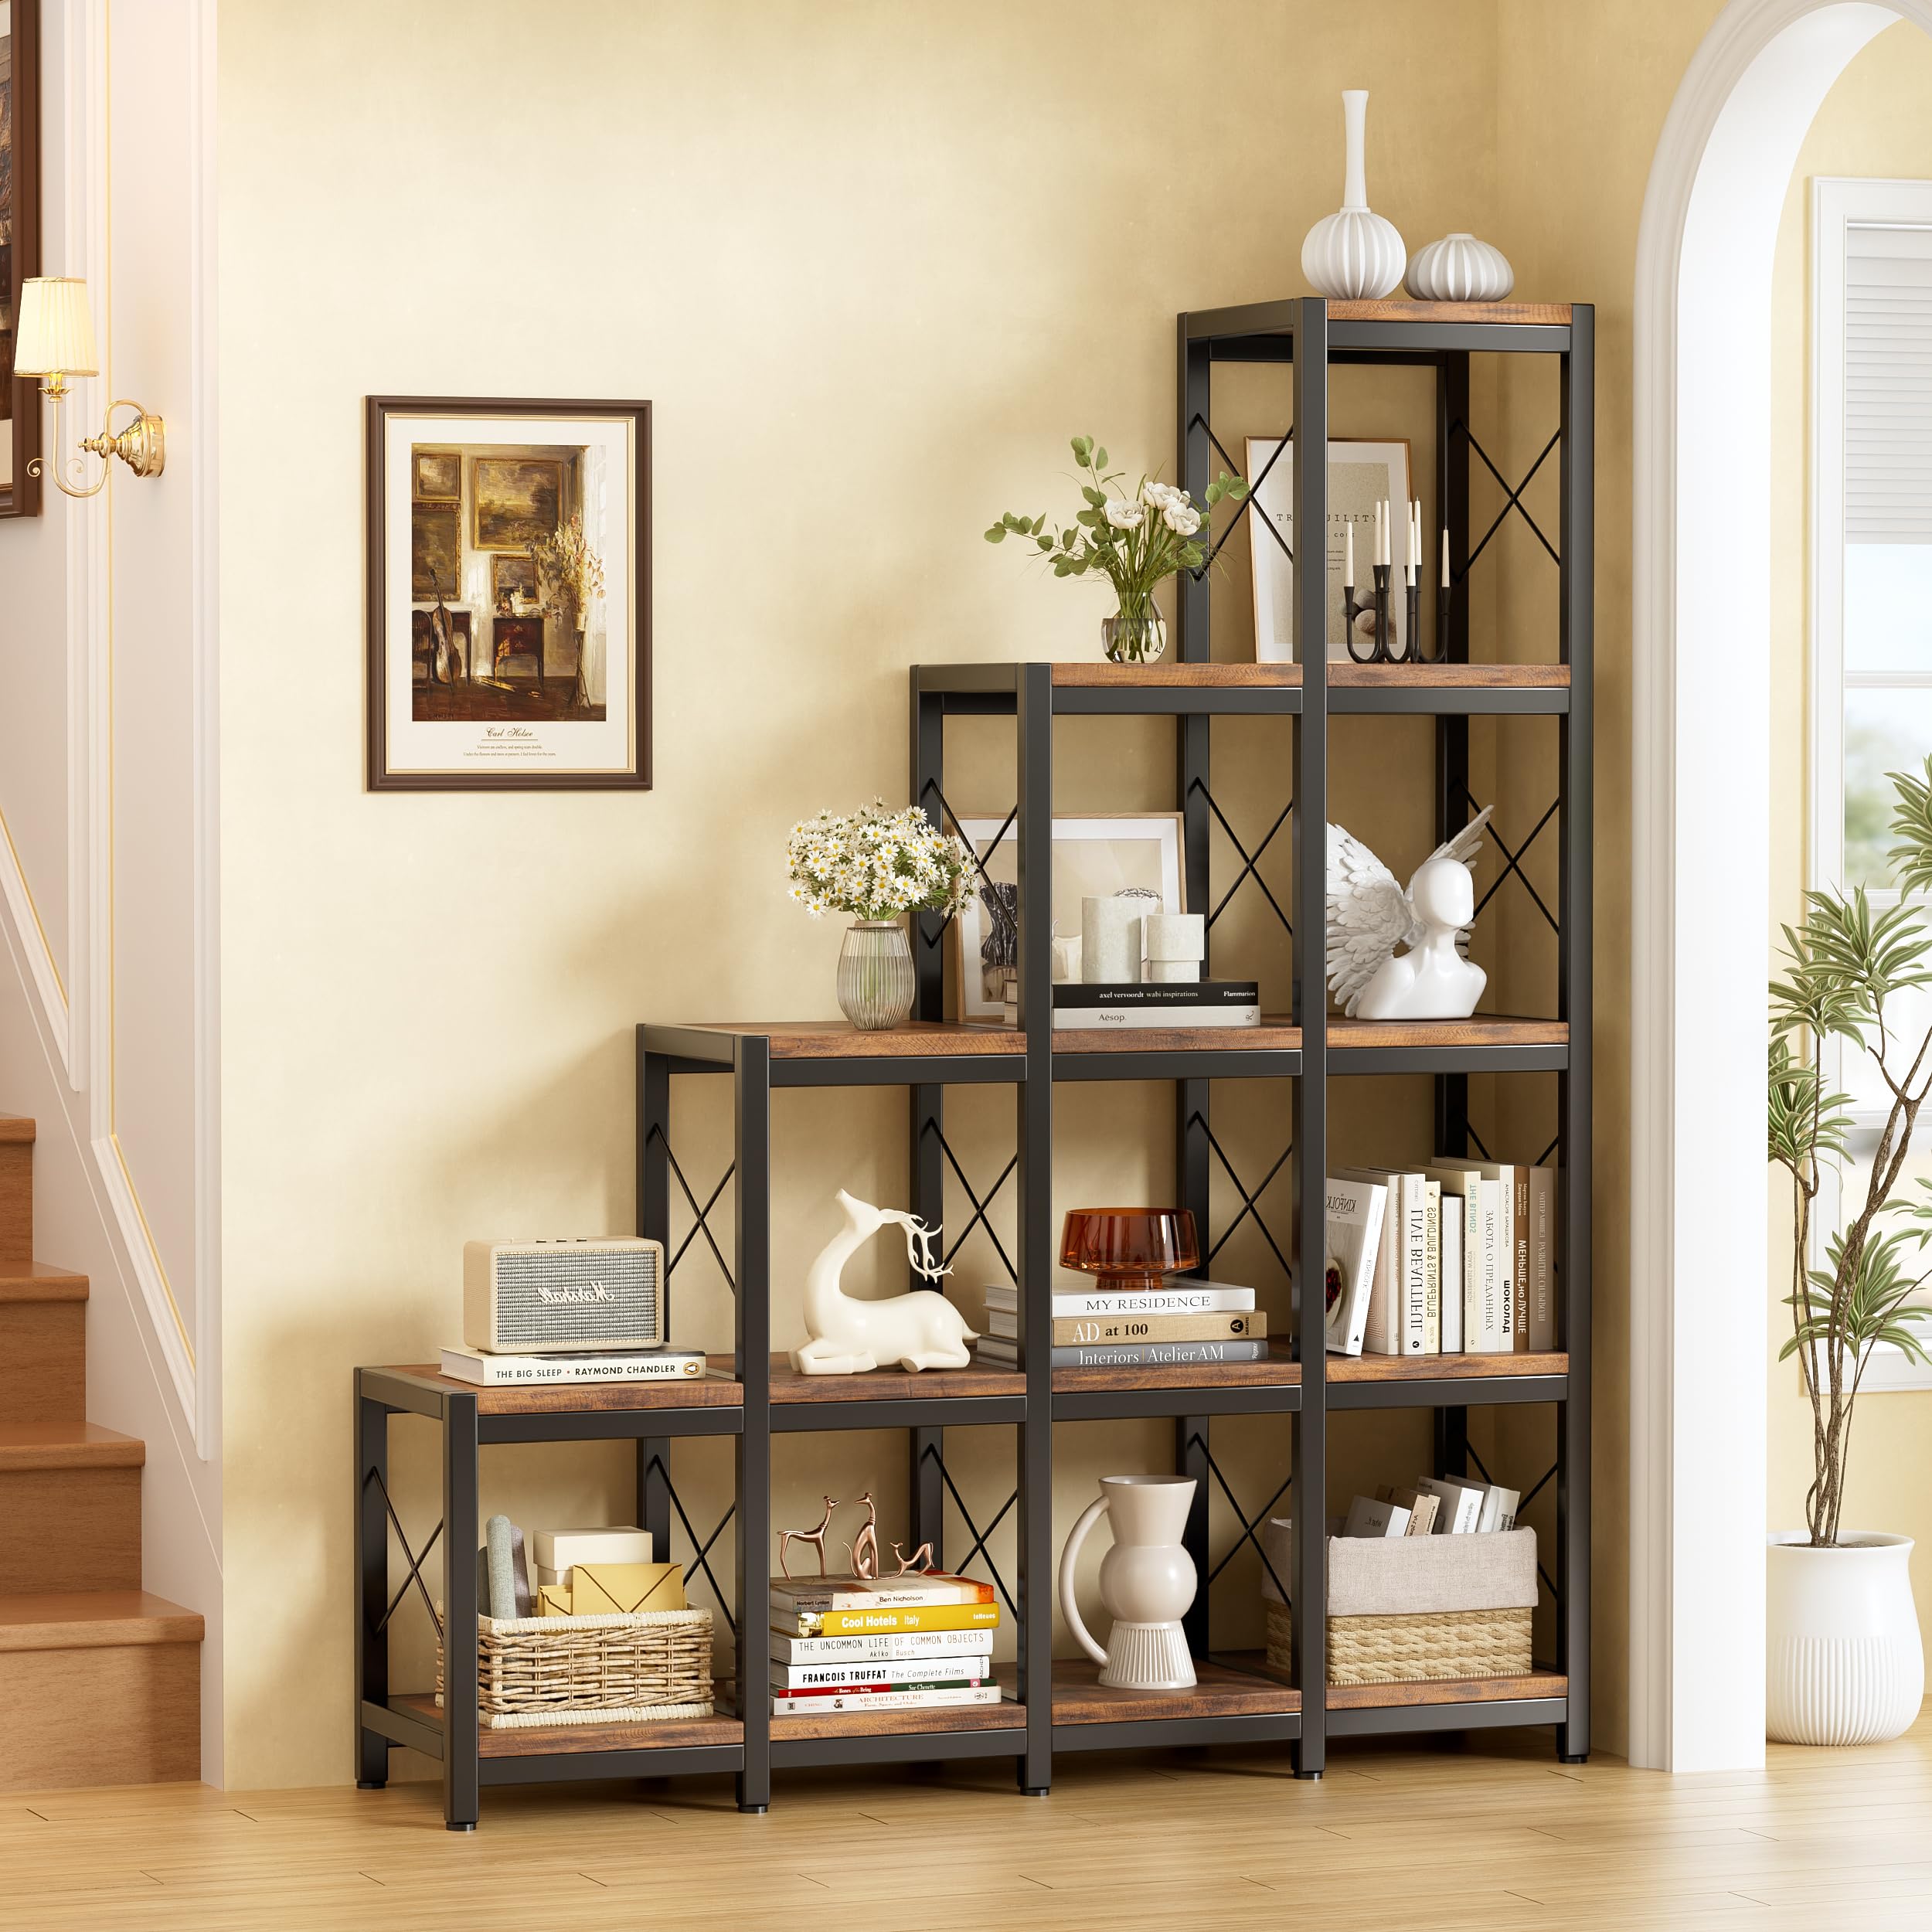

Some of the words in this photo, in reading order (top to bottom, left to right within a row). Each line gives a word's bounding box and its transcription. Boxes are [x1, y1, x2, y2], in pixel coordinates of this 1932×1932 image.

[1277, 514, 1376, 522] TRUILITY
[486, 727, 505, 737] Carl
[1162, 990, 1199, 998] inspirations
[1485, 1210, 1494, 1250] ЗАБОТА
[1086, 1300, 1112, 1311] MY
[1118, 1296, 1211, 1309] RESIDENCE
[1485, 1264, 1494, 1330] ПРЕДАННЫХ
[1072, 1322, 1100, 1342] AD
[1105, 1325, 1119, 1336] at
[1124, 1323, 1148, 1335] 100
[1079, 1350, 1139, 1365] Interiors
[1148, 1346, 1196, 1362] Atelier
[1197, 1345, 1225, 1360] AM
[536, 1369, 562, 1377] SLEEP
[575, 1366, 623, 1376] RAYMOND
[627, 1365, 675, 1374] CHANDLER
[842, 1616, 863, 1628] Cool
[866, 1614, 897, 1627] Hotels
[904, 1615, 920, 1626] Italy
[799, 1641, 815, 1651] THE
[820, 1640, 862, 1651] UNCOMMON
[869, 1638, 889, 1648] LIFE
[894, 1637, 904, 1647] OF
[910, 1635, 941, 1646] COMMON
[947, 1633, 985, 1644] OBJECTS
[802, 1672, 845, 1683] FRANCOIS
[850, 1669, 886, 1681] TRUFFAT
[907, 1668, 942, 1679] Complete
[859, 1694, 924, 1703] ARCHITECTURE
